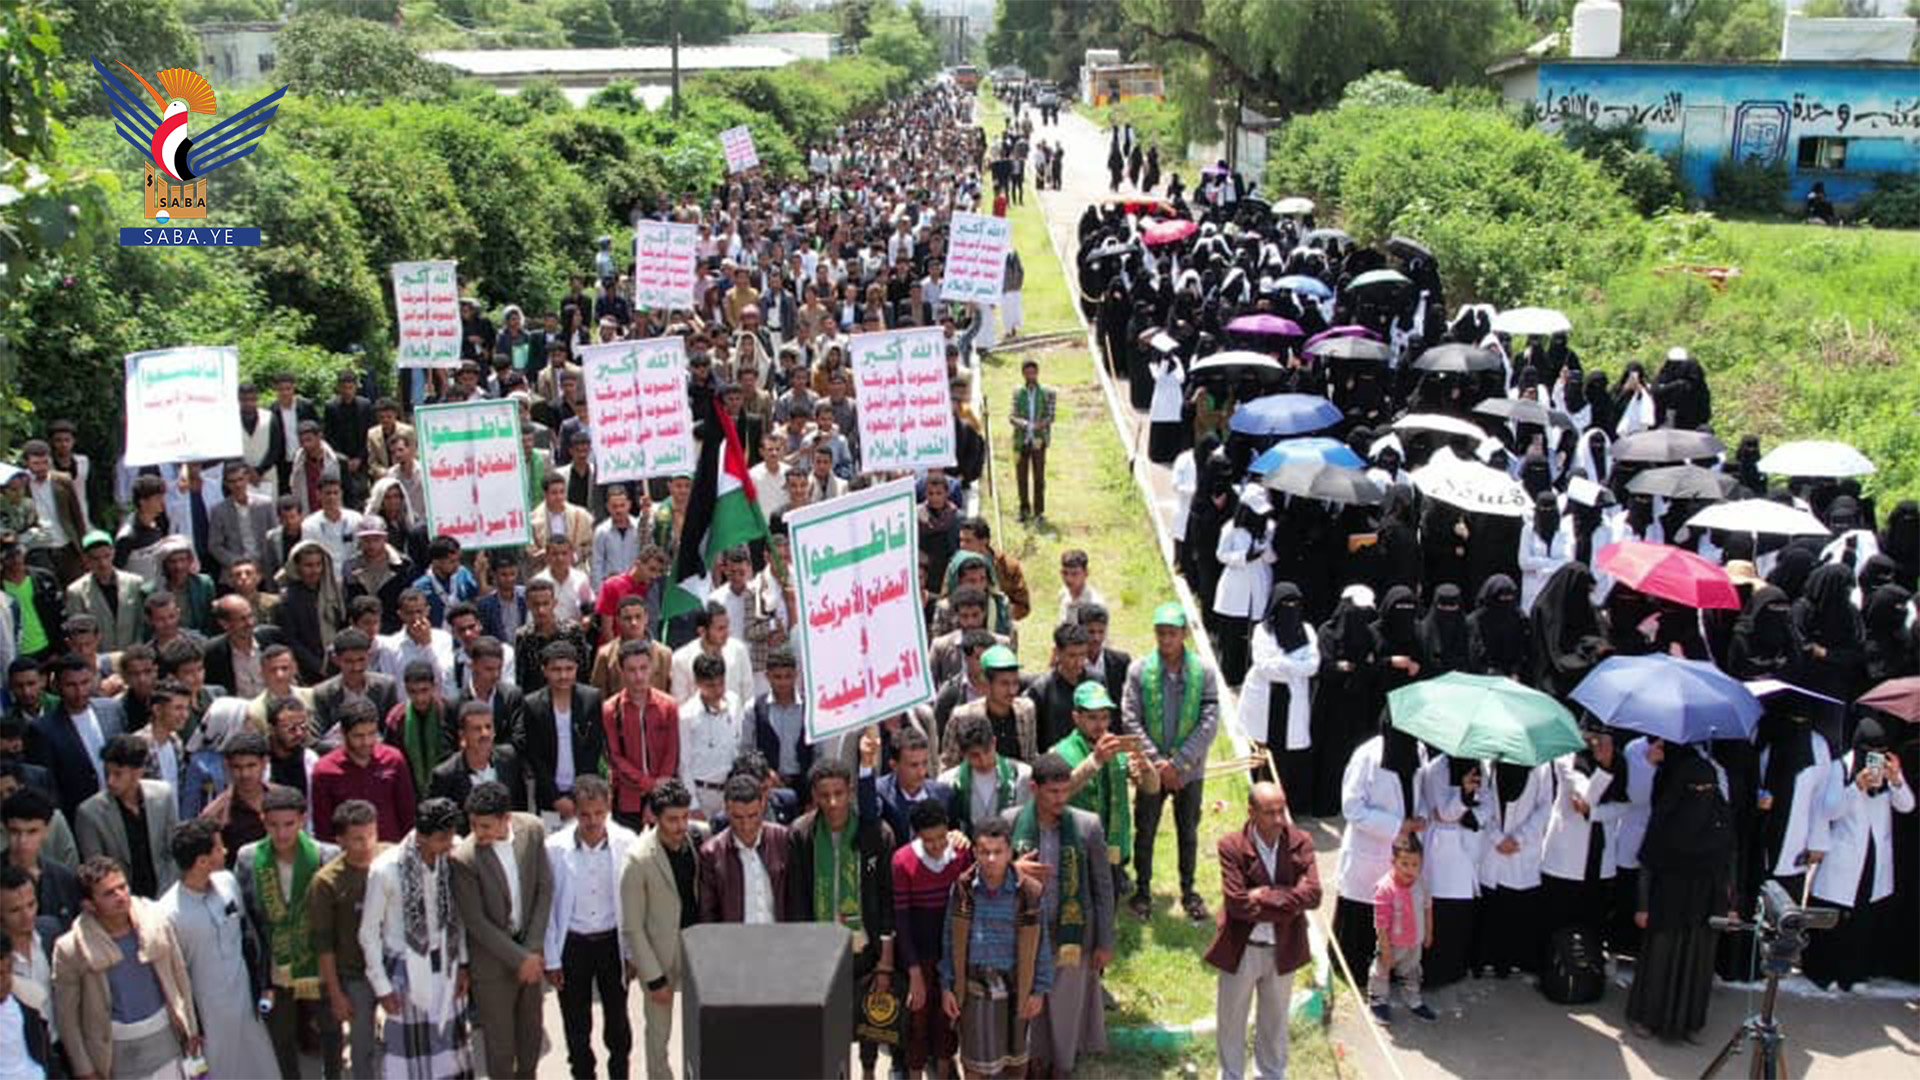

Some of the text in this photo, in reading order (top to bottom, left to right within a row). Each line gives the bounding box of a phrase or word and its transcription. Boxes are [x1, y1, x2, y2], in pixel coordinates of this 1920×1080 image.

[1793, 92, 1850, 132] وحدة
[645, 350, 679, 369] الله
[910, 341, 942, 358] الله
[801, 513, 907, 586] قاطعوا
[808, 569, 909, 633] البضائع الأمريكية
[859, 626, 869, 655] و
[817, 649, 921, 716] الإسرائيلية
